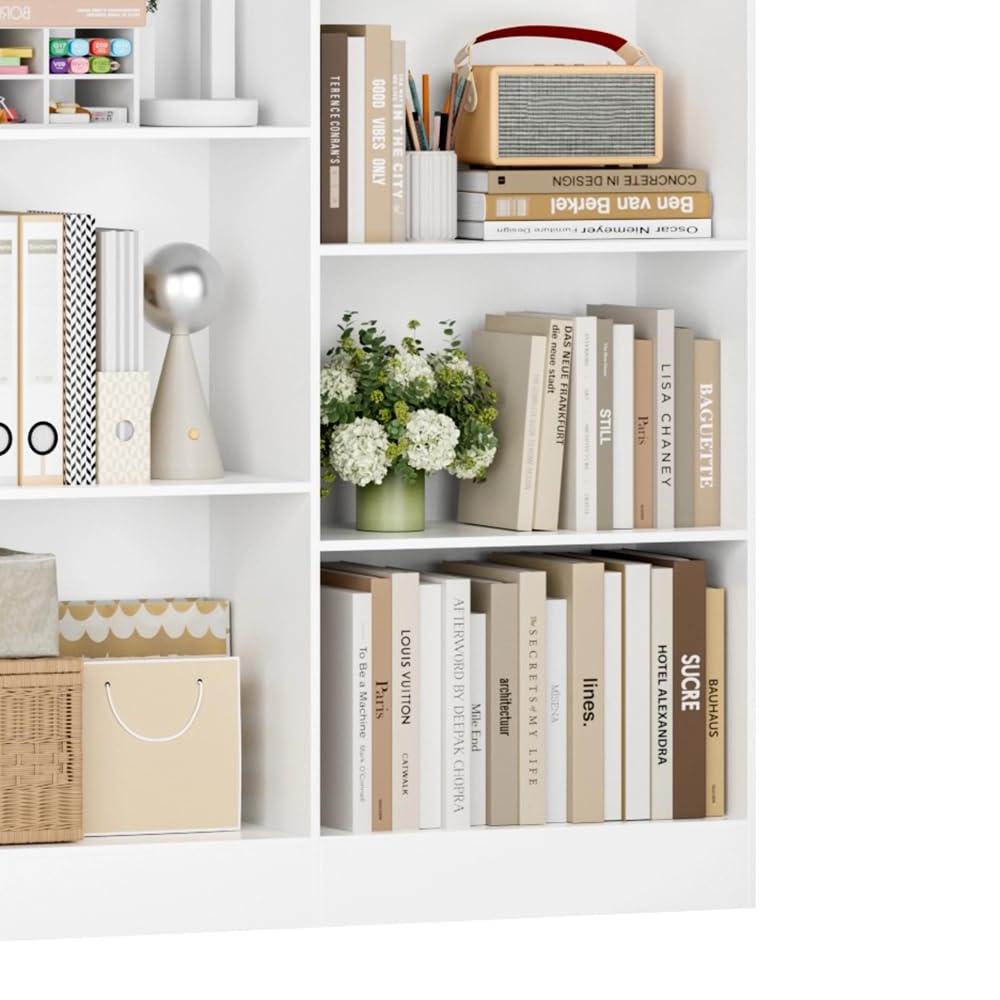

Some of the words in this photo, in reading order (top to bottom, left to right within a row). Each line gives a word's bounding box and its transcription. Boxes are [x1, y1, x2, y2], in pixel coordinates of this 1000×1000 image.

[330, 76, 340, 118] TERENCE
[372, 79, 386, 108] GOOD
[392, 103, 403, 120] IN
[330, 121, 340, 164] CONRAN'S
[372, 117, 386, 150] VIBES
[392, 126, 403, 157] THE
[372, 158, 386, 185] ONLY
[392, 163, 403, 199] CITY
[553, 176, 602, 186] DESIGN
[607, 176, 619, 186] IN
[624, 175, 696, 186] CONCRETE
[551, 197, 611, 214] Berkel
[617, 197, 651, 211] van
[656, 196, 694, 213] Ben
[582, 225, 650, 235] Niemeyer
[656, 226, 698, 234] Oscar
[552, 325, 560, 339] die
[563, 325, 573, 348] DAS
[549, 342, 557, 366] neue
[561, 351, 570, 379] NEUE
[547, 370, 556, 394] stadt
[662, 364, 671, 403] LISA
[556, 383, 569, 444] FRANKFURT
[600, 409, 612, 445] STILL
[638, 417, 648, 445] Paris
[699, 383, 713, 488] BAGUETTE
[661, 414, 671, 486] CHANEY
[360, 648, 367, 659] To
[401, 630, 410, 667] LOUIS
[453, 598, 465, 680] AFTERWORD
[359, 663, 367, 677] Be
[528, 629, 538, 705] SECRETS
[658, 645, 667, 685] HOTEL
[401, 672, 411, 724] VUITTON
[453, 683, 465, 701] BY
[681, 654, 700, 712] SUCRE
[376, 682, 388, 719] Paris
[472, 704, 480, 726] Mile
[499, 678, 510, 736] architectuur
[583, 679, 598, 726] lines.
[708, 679, 719, 738] BAUHAUS
[453, 706, 465, 756] DEEPAK
[472, 731, 480, 751] End
[528, 715, 538, 737] MY
[658, 689, 667, 765] ALEXANDRA
[528, 748, 538, 787] LIFE
[453, 760, 465, 813] CHOPRA
